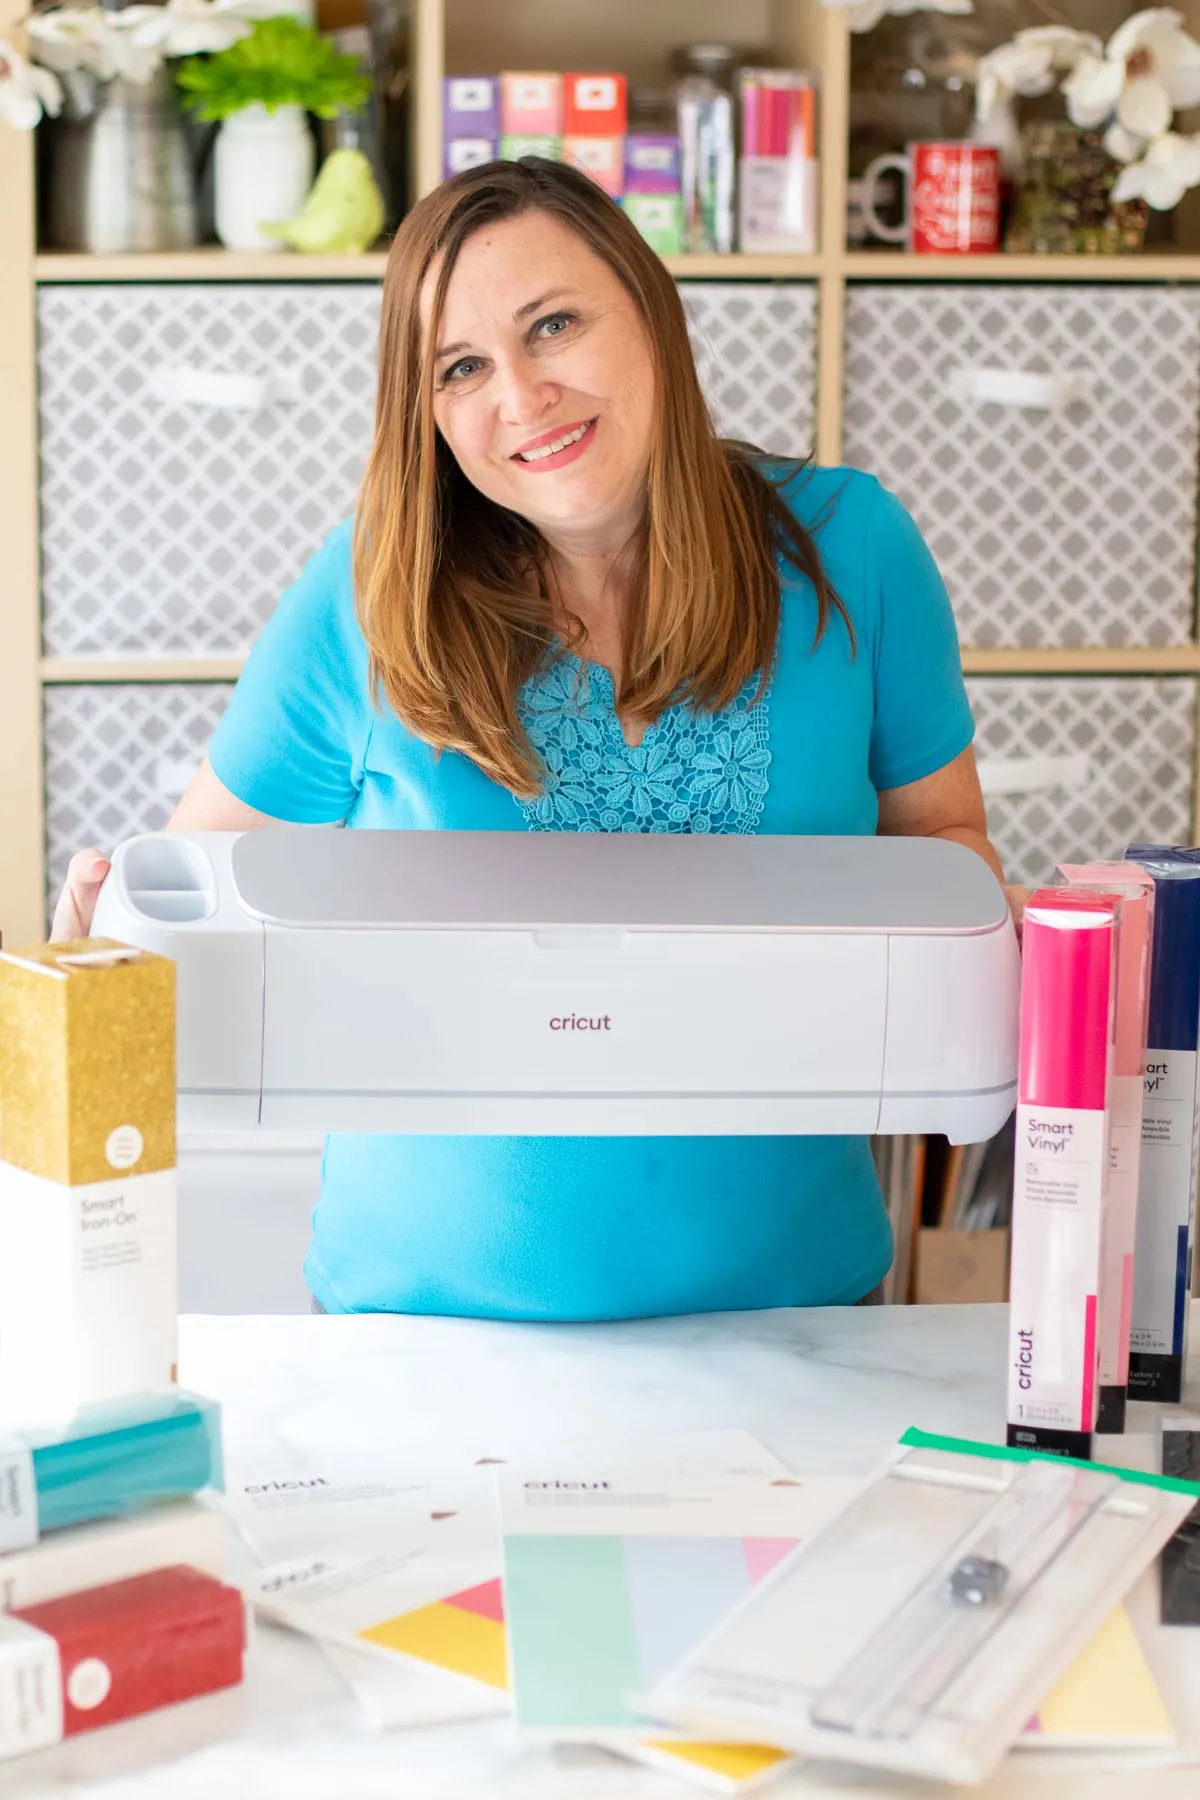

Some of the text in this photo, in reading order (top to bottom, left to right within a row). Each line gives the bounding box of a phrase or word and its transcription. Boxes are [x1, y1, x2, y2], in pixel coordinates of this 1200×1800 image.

[549, 1013, 612, 1031] cricut
[1146, 1063, 1168, 1074] art
[1028, 1119, 1074, 1135] Smart
[1014, 1329, 1033, 1390] cricut
[524, 1480, 611, 1490] cricut
